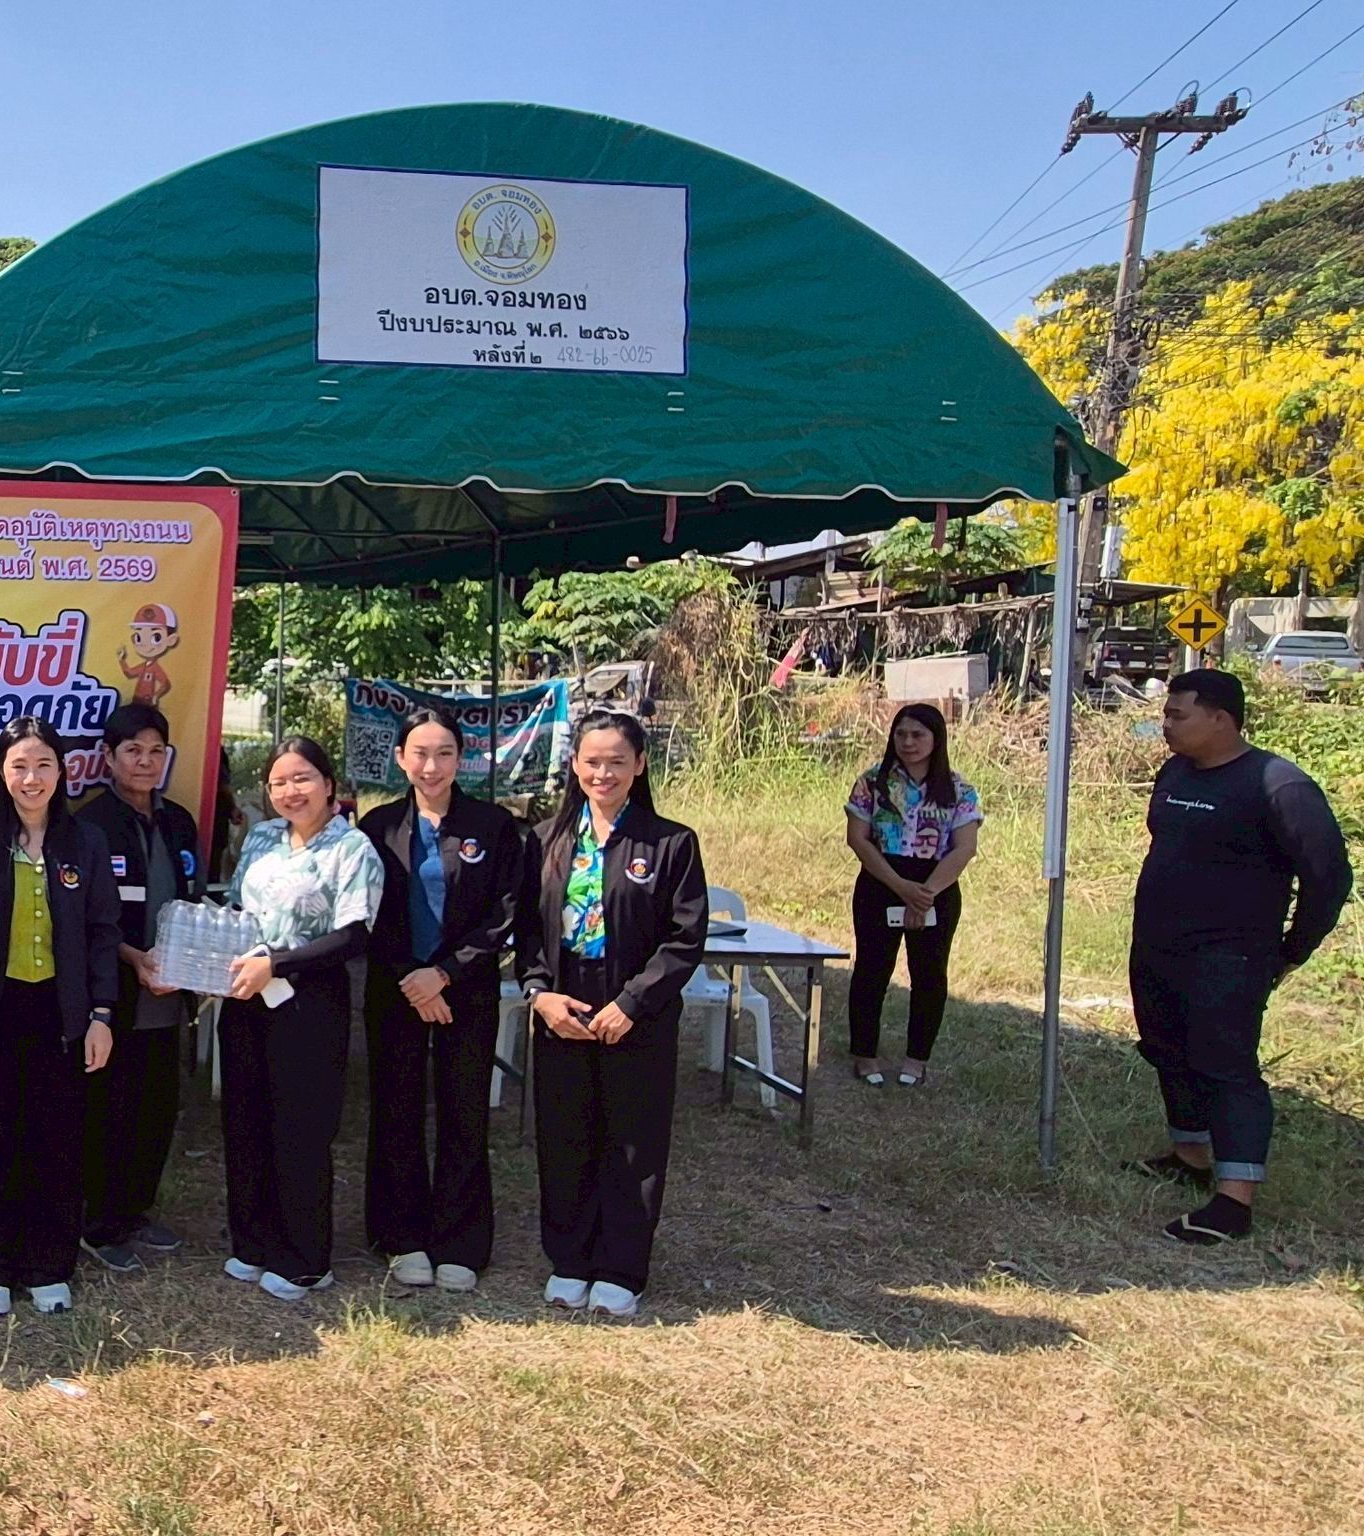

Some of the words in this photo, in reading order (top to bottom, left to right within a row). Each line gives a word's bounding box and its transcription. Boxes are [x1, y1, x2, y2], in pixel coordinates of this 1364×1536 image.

[424, 285, 587, 311] อบต.จอมทอง
[377, 308, 516, 336] ปีงบประมาณ
[526, 322, 568, 339] พ.ศ.
[579, 325, 630, 341] ๒๕๖๖
[473, 340, 526, 364] หลังที่
[531, 353, 542, 365] ๒
[42, 558, 90, 578] พ.ศ.
[99, 558, 153, 578] 2569
